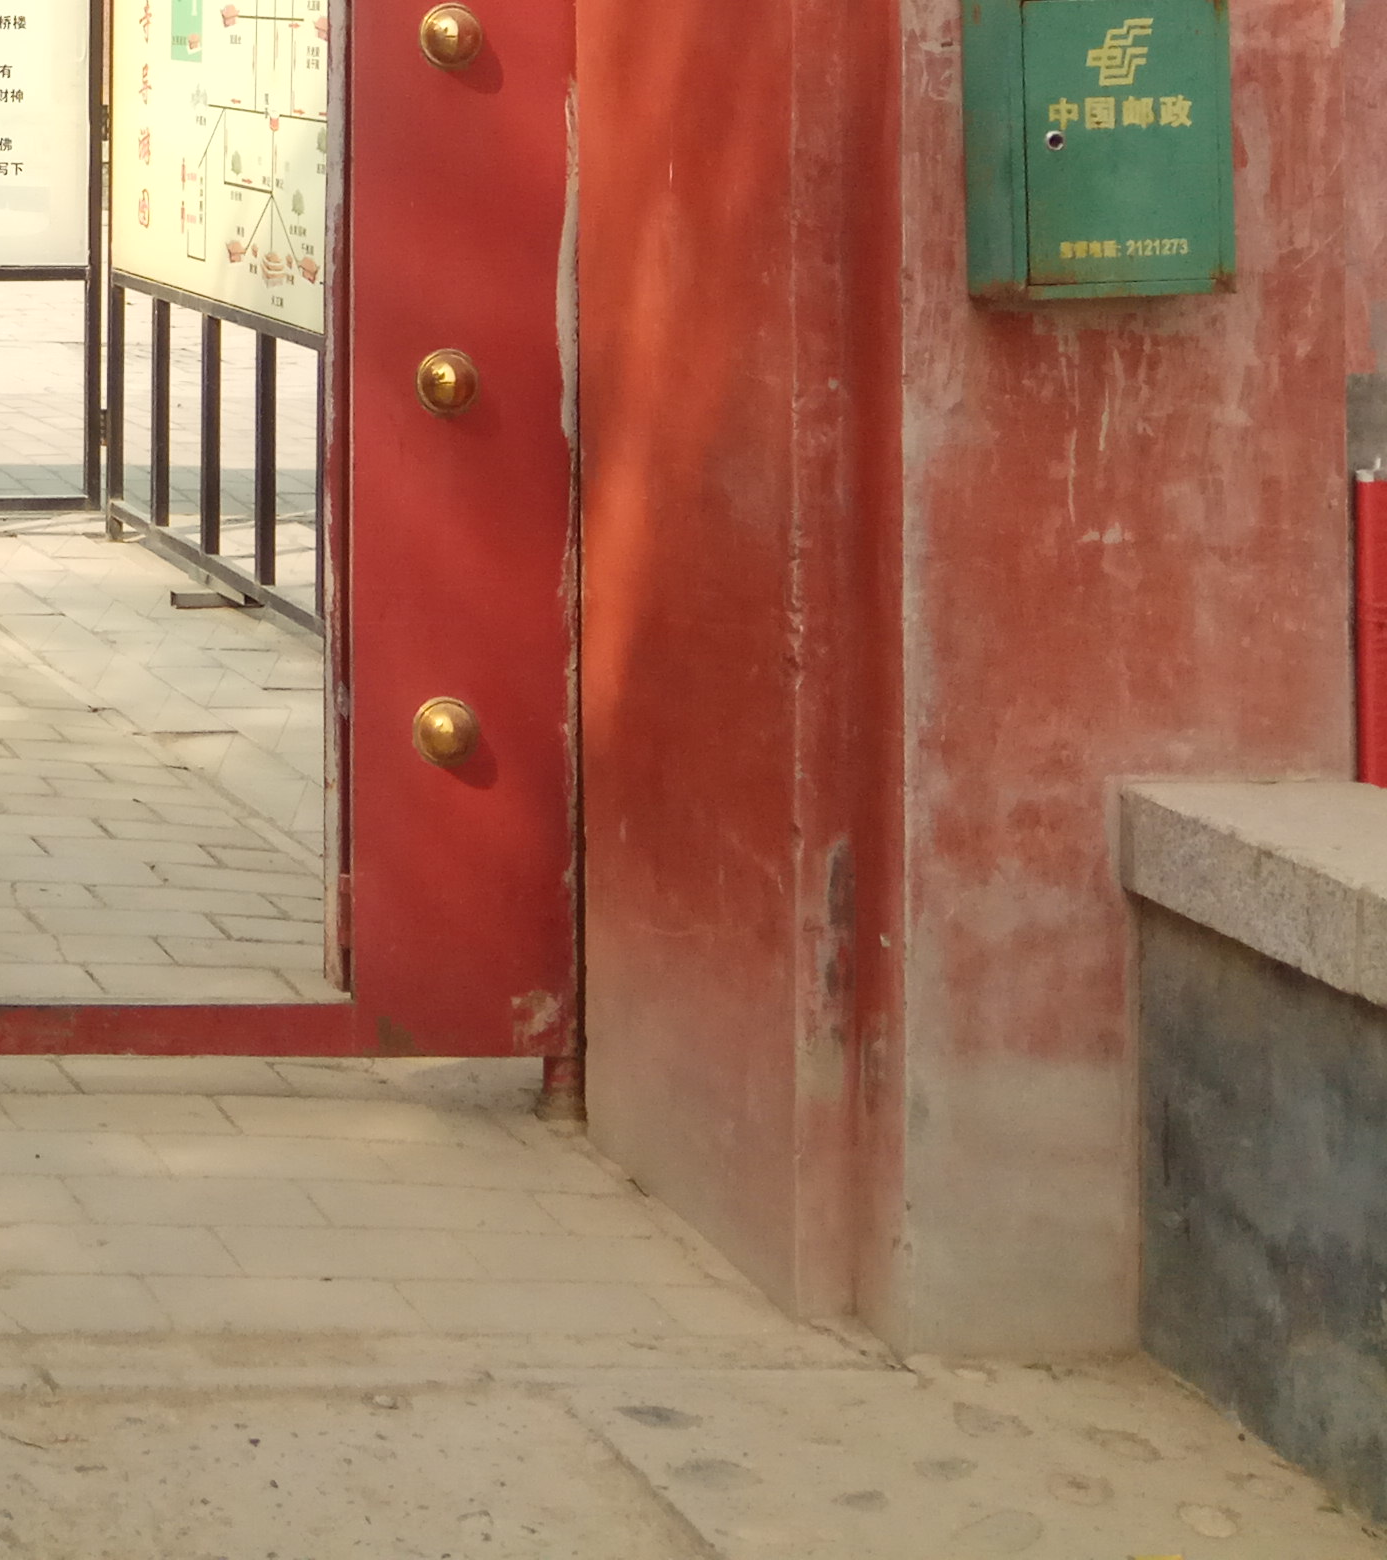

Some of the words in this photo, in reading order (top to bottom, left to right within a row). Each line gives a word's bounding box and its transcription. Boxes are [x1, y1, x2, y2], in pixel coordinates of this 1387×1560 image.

[1049, 94, 1192, 130] 中国邮政
[1126, 238, 1188, 256] 2121273
